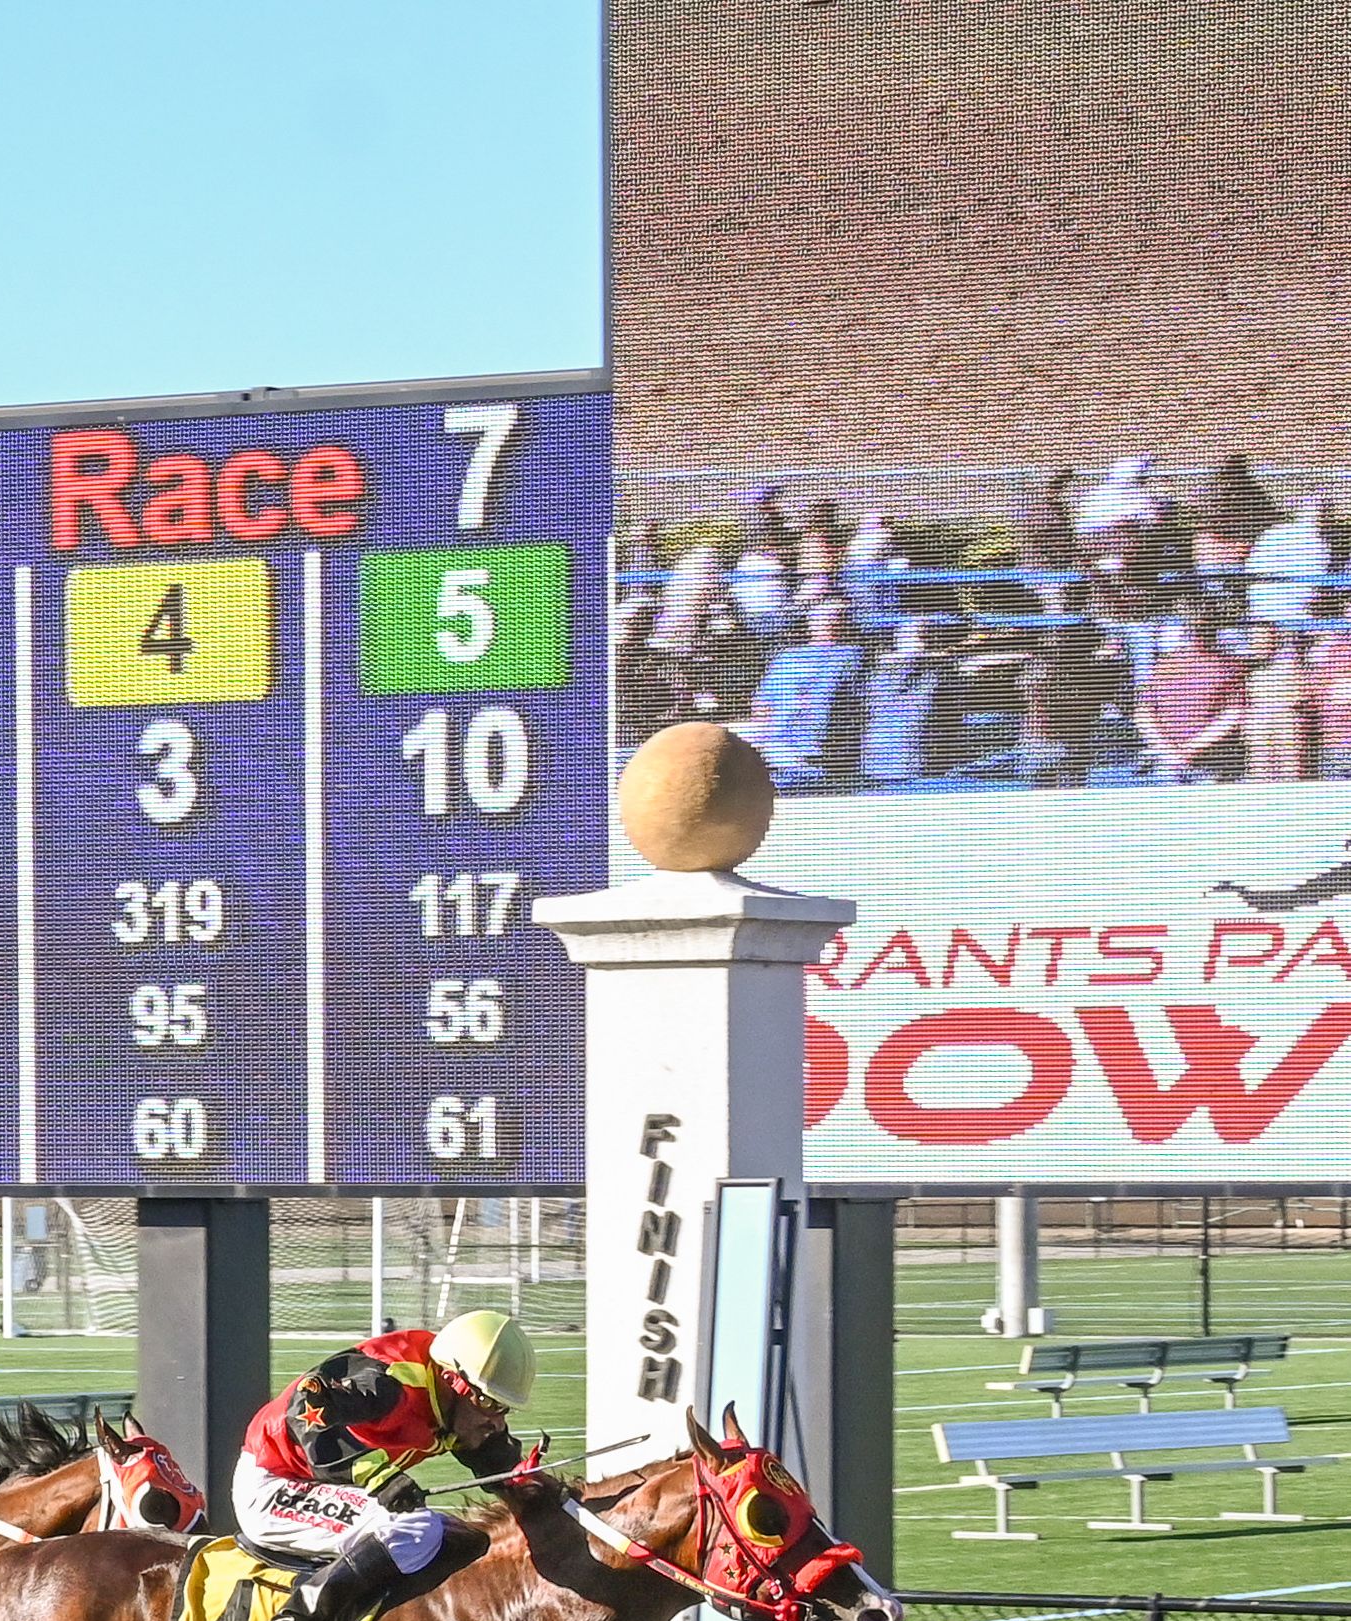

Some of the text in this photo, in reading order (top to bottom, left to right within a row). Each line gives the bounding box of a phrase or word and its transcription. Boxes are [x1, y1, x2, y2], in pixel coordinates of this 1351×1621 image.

[50, 407, 518, 550] Race 7
[141, 585, 193, 675] 4
[437, 569, 496, 662] 5
[135, 721, 199, 824] 3
[403, 707, 532, 816] 10
[111, 880, 225, 944] 319
[409, 873, 521, 939] 117
[803, 919, 1351, 988] RANTS PA
[127, 985, 209, 1046] 95
[427, 981, 505, 1042] 56
[132, 1099, 209, 1158] 60
[425, 1097, 497, 1158] 61
[638, 1113, 683, 1403] FINISH
[334, 1488, 368, 1508] HORSE
